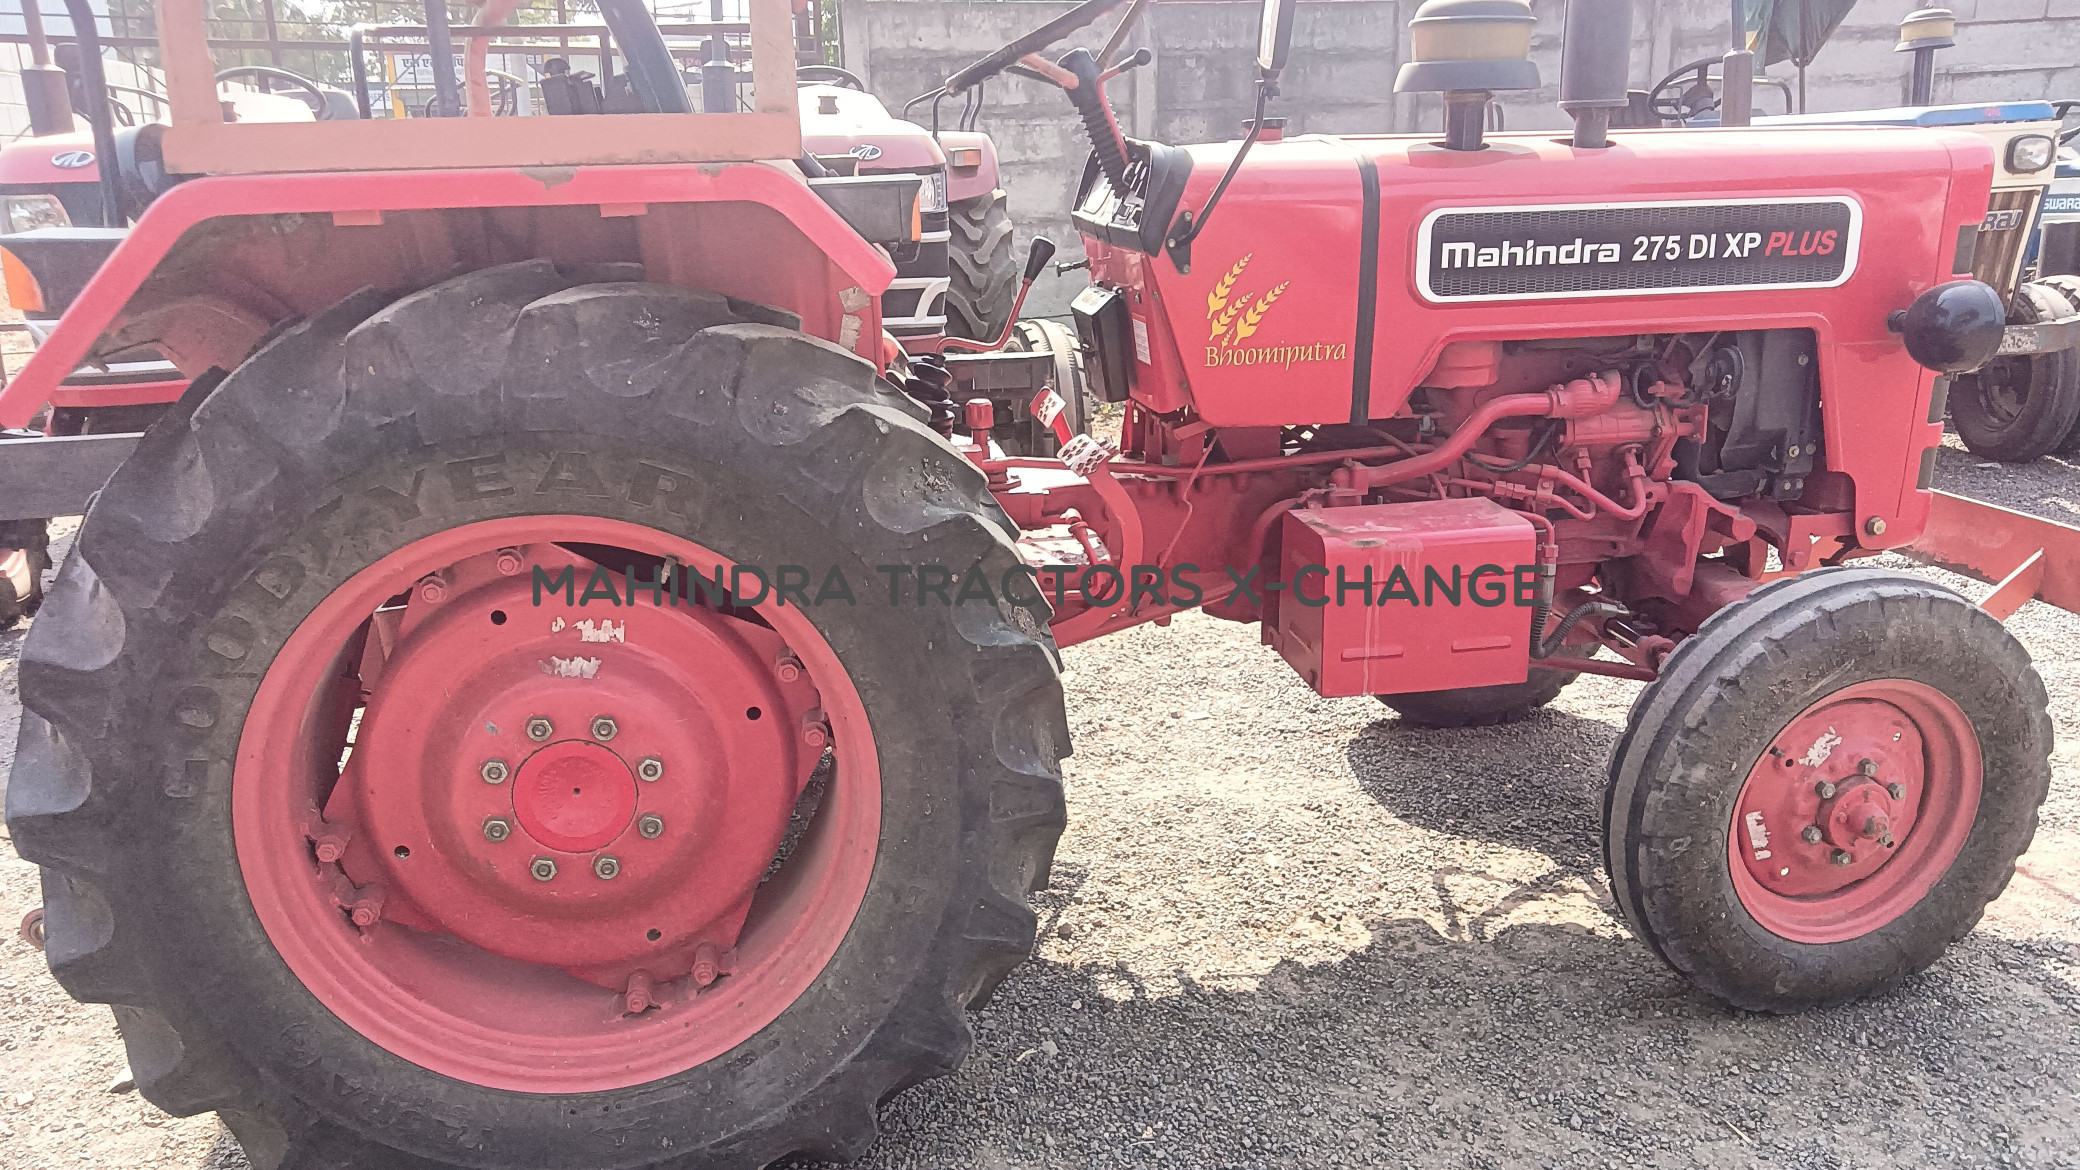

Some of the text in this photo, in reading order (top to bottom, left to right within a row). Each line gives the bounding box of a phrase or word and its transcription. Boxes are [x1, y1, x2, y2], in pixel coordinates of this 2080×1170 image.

[1441, 229, 1838, 269] Mahindra 275 DI XP PLUS
[1204, 339, 1347, 371] Bhoomiputra
[160, 450, 702, 800] GOODYEAR
